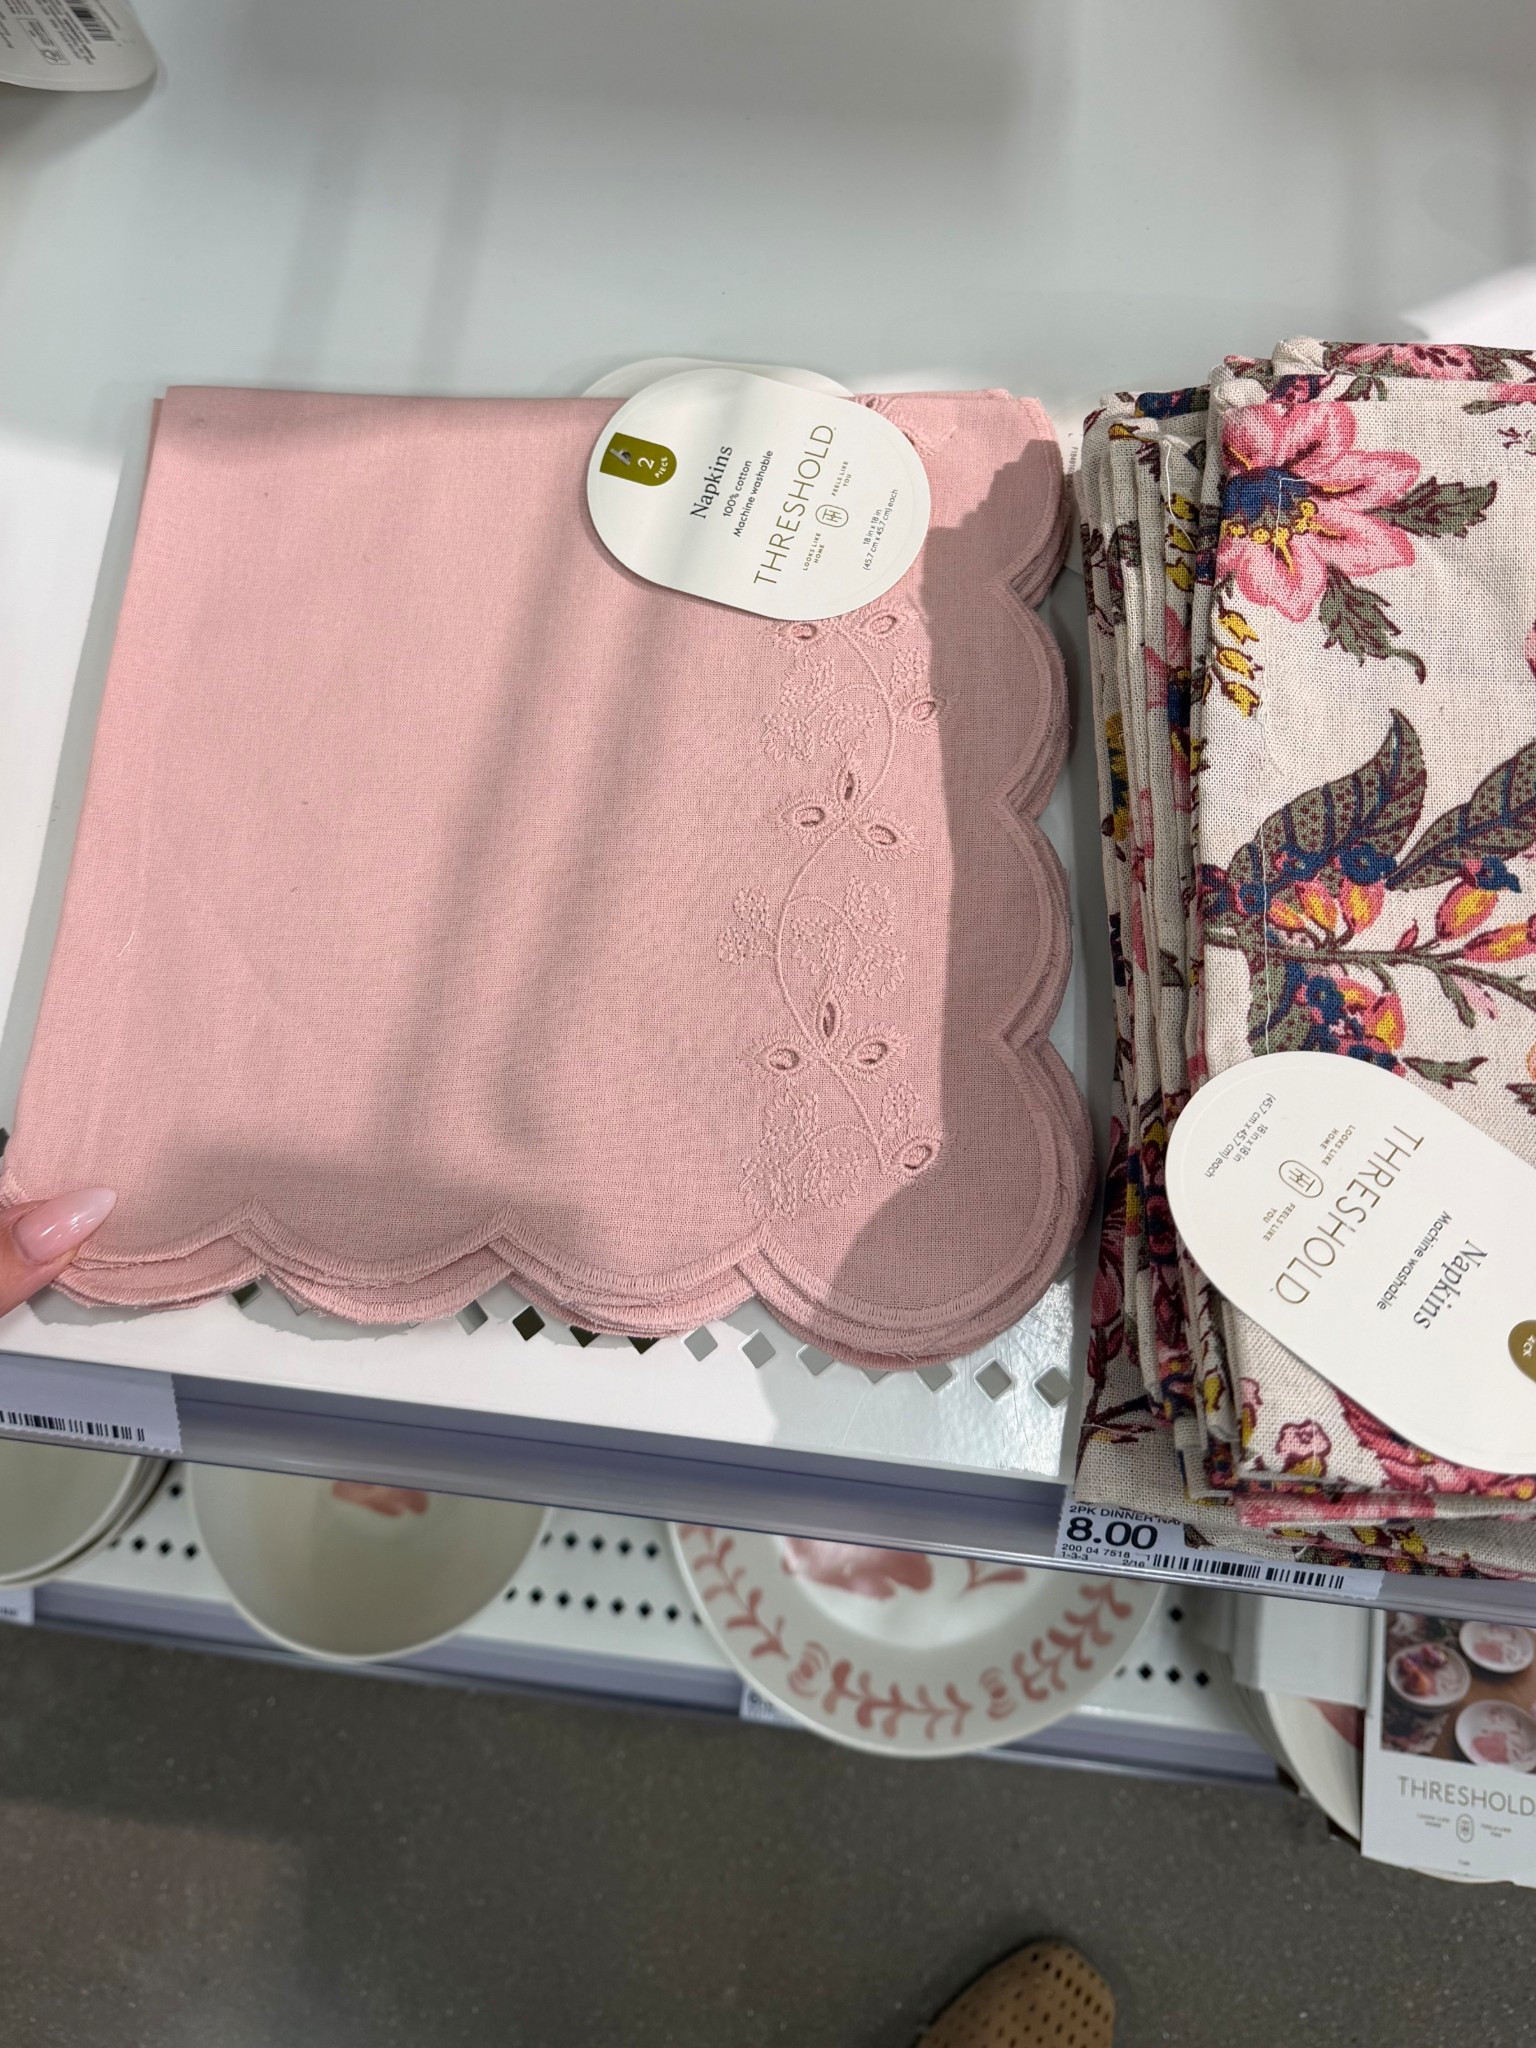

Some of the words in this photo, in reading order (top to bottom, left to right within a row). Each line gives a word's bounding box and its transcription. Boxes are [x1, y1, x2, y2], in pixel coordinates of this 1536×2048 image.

[637, 457, 655, 470] 2
[654, 457, 669, 478] PIECE
[690, 446, 733, 519] Napkins
[831, 477, 842, 496] FEELS
[839, 461, 849, 476] LIKE
[842, 474, 852, 487] YOU
[723, 493, 739, 517] 100%
[735, 460, 752, 491] cotton
[733, 496, 756, 537] Machine
[750, 450, 774, 495] washable
[753, 425, 834, 584] THRESHOLD
[887, 489, 898, 508] each
[882, 508, 893, 521] cm)
[862, 536, 870, 545] 18
[870, 516, 879, 524] 18
[876, 520, 886, 536] 45.7
[803, 548, 815, 571] LOOKS
[811, 532, 821, 547] LIKE
[814, 544, 825, 563] HOME
[870, 542, 879, 553] cm
[862, 552, 875, 571] (45.7
[1259, 1093, 1276, 1115] (45.7
[1248, 1111, 1261, 1124] cm
[1233, 1129, 1248, 1146] 45.7
[1250, 1131, 1262, 1140] in
[1257, 1124, 1268, 1134] 18
[1334, 1124, 1356, 1149] LOOKS
[1319, 1128, 1339, 1150] HOME
[1218, 1143, 1234, 1160] cm)
[1233, 1153, 1245, 1162] in
[1239, 1145, 1251, 1156] 18
[1321, 1149, 1337, 1166] LIKE
[1204, 1157, 1223, 1178] each
[1263, 1208, 1278, 1223] YOU
[1274, 1125, 1425, 1305] THRESHOLD
[1276, 1202, 1296, 1225] FEELS
[1263, 1223, 1280, 1242] LIKE
[1414, 1210, 1452, 1258] Machine
[1376, 1258, 1419, 1310] washable
[1413, 1239, 1488, 1329] Napkins
[1069, 1505, 1097, 1516] 2PK
[1100, 1508, 1153, 1523] DINNER
[1066, 1516, 1158, 1550] 8.00
[1061, 1543, 1082, 1552] 200
[1086, 1547, 1099, 1555] 04
[1103, 1549, 1130, 1559] 7518
[1061, 1551, 1089, 1561] 1-3-3
[1122, 1559, 1145, 1568] 2/16
[1398, 1775, 1536, 1817] THRESHOLD
